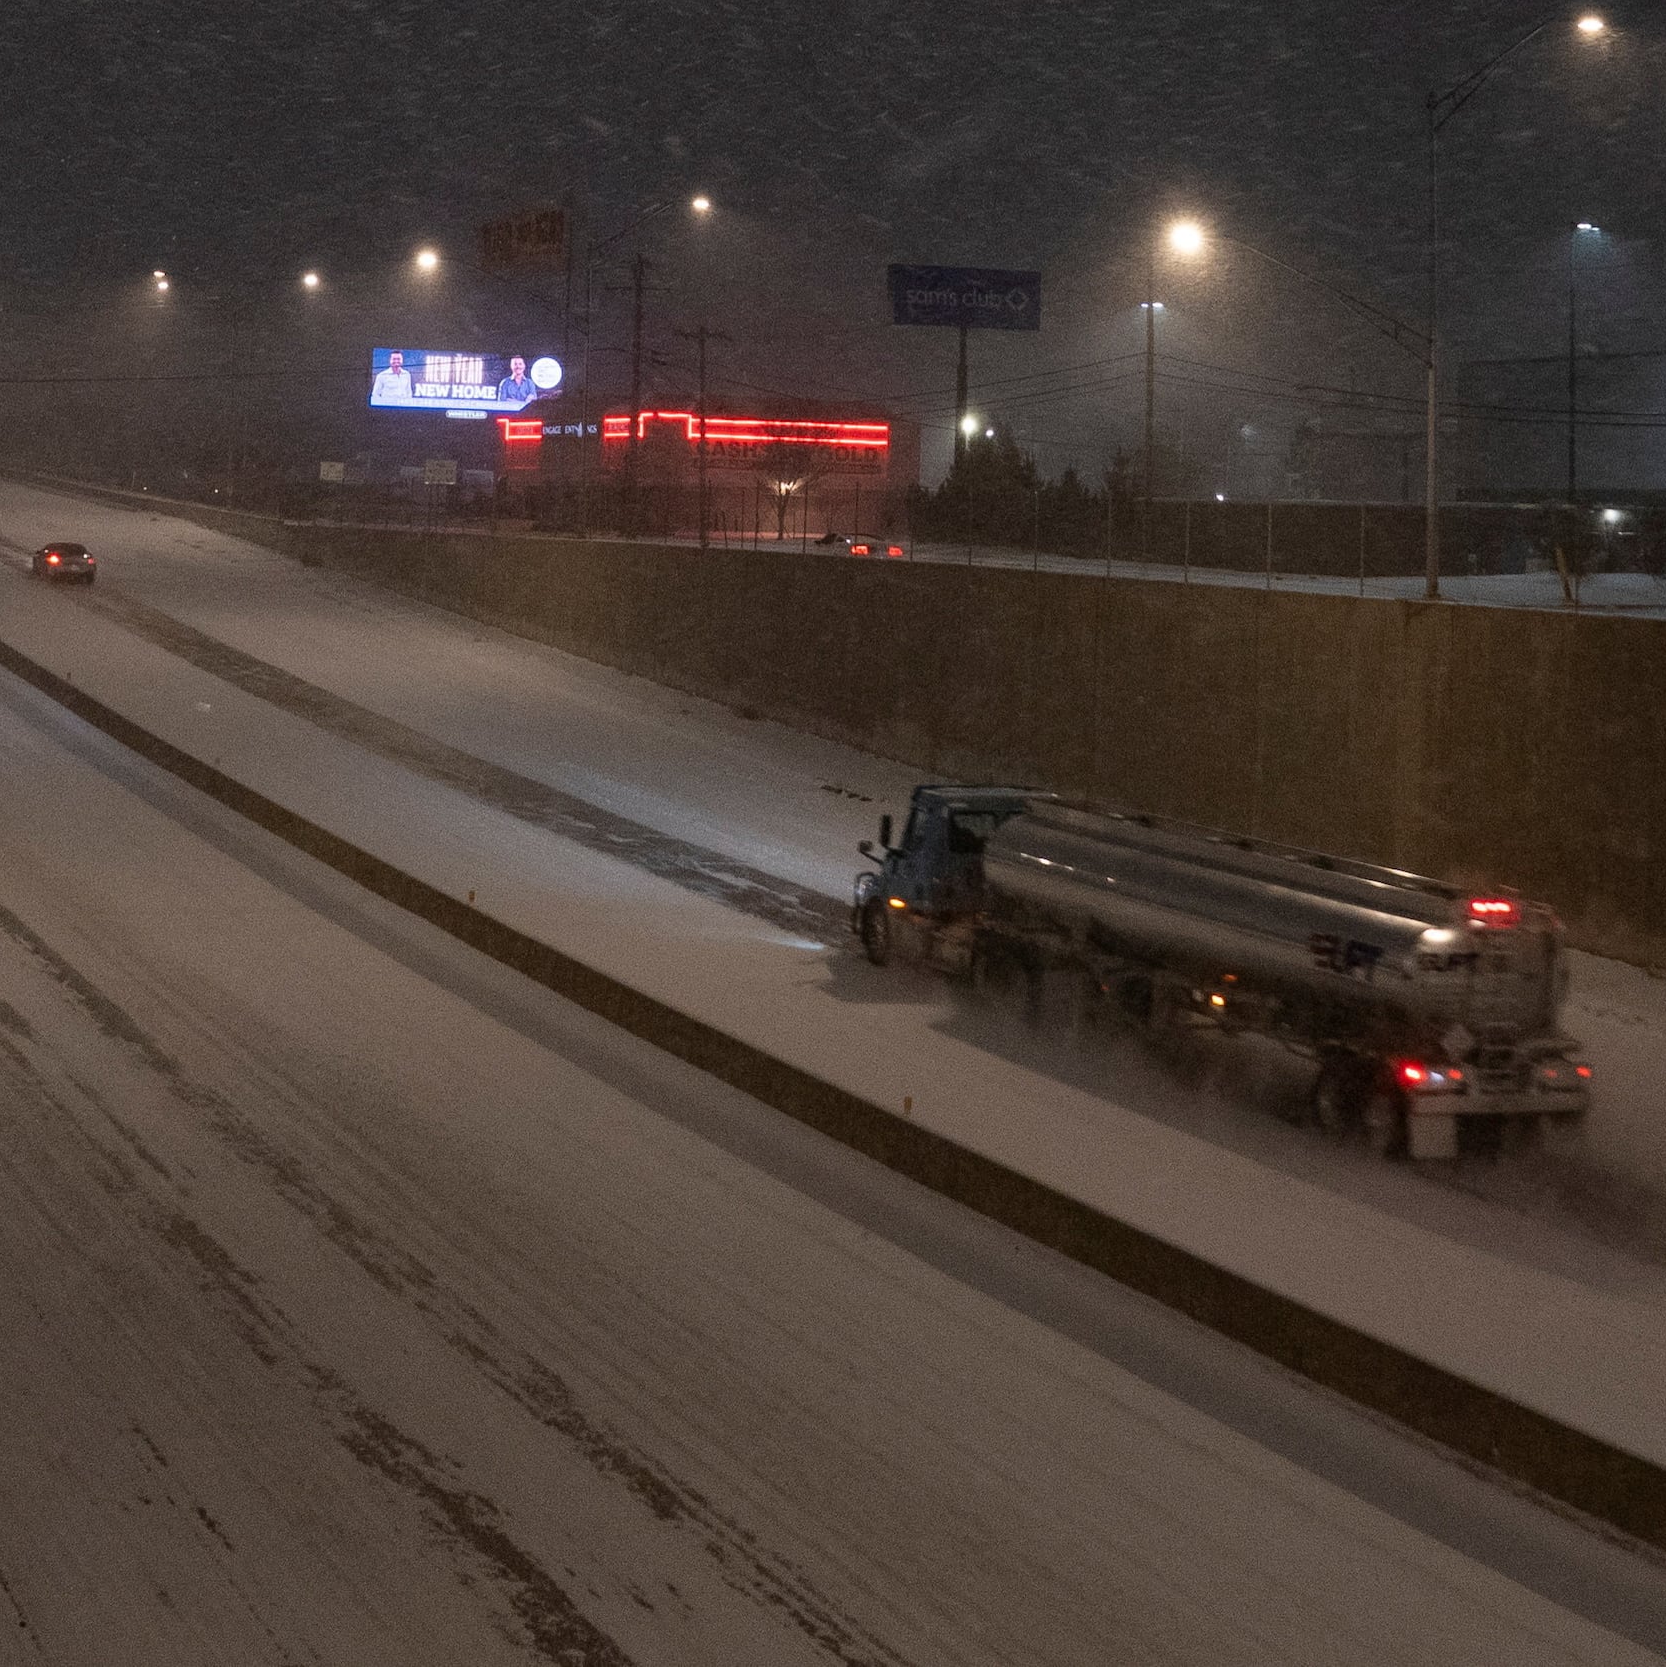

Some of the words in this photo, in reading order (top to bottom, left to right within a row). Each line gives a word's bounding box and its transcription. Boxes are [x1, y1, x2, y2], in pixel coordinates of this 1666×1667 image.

[962, 286, 1002, 309] club
[425, 355, 452, 382] NEW
[415, 383, 450, 398] NEW
[451, 385, 497, 400] HOME
